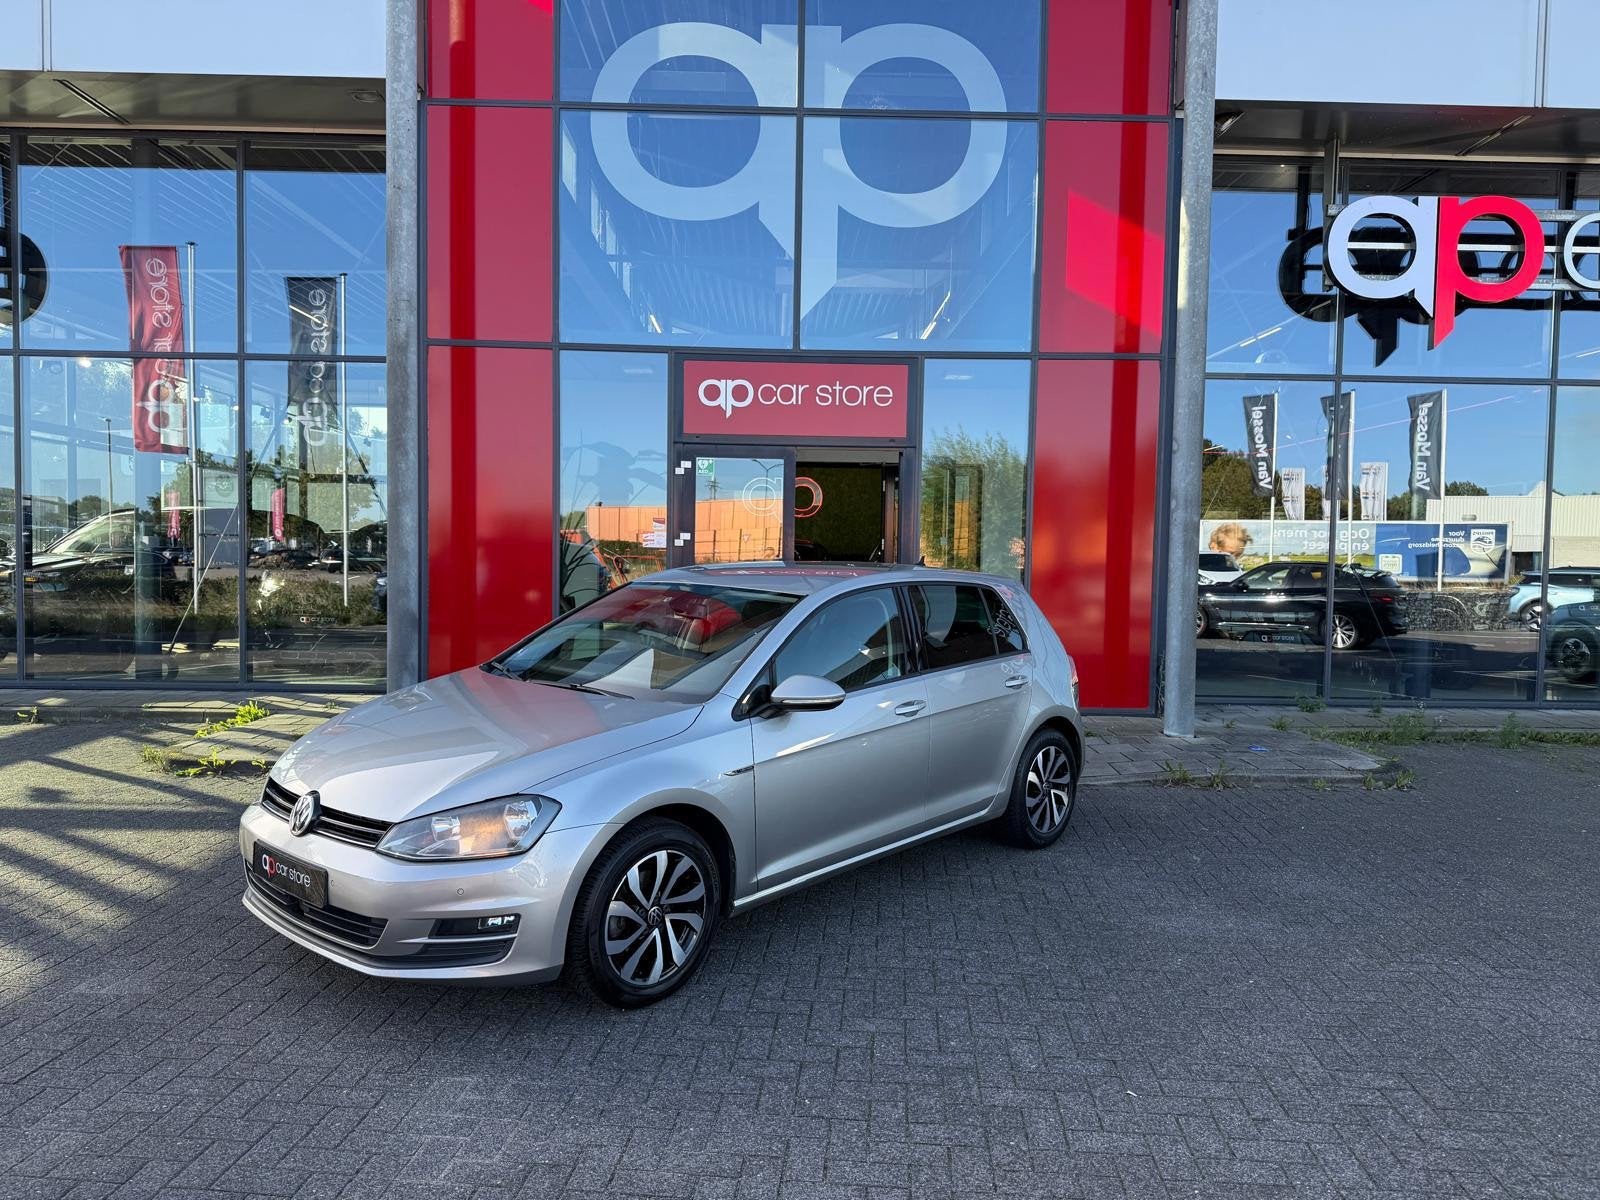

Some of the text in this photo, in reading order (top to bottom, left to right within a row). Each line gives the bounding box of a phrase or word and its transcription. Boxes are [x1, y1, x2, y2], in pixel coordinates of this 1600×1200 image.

[757, 383, 810, 405] car
[815, 381, 894, 407] store
[275, 862, 288, 876] car
[288, 867, 311, 887] store
